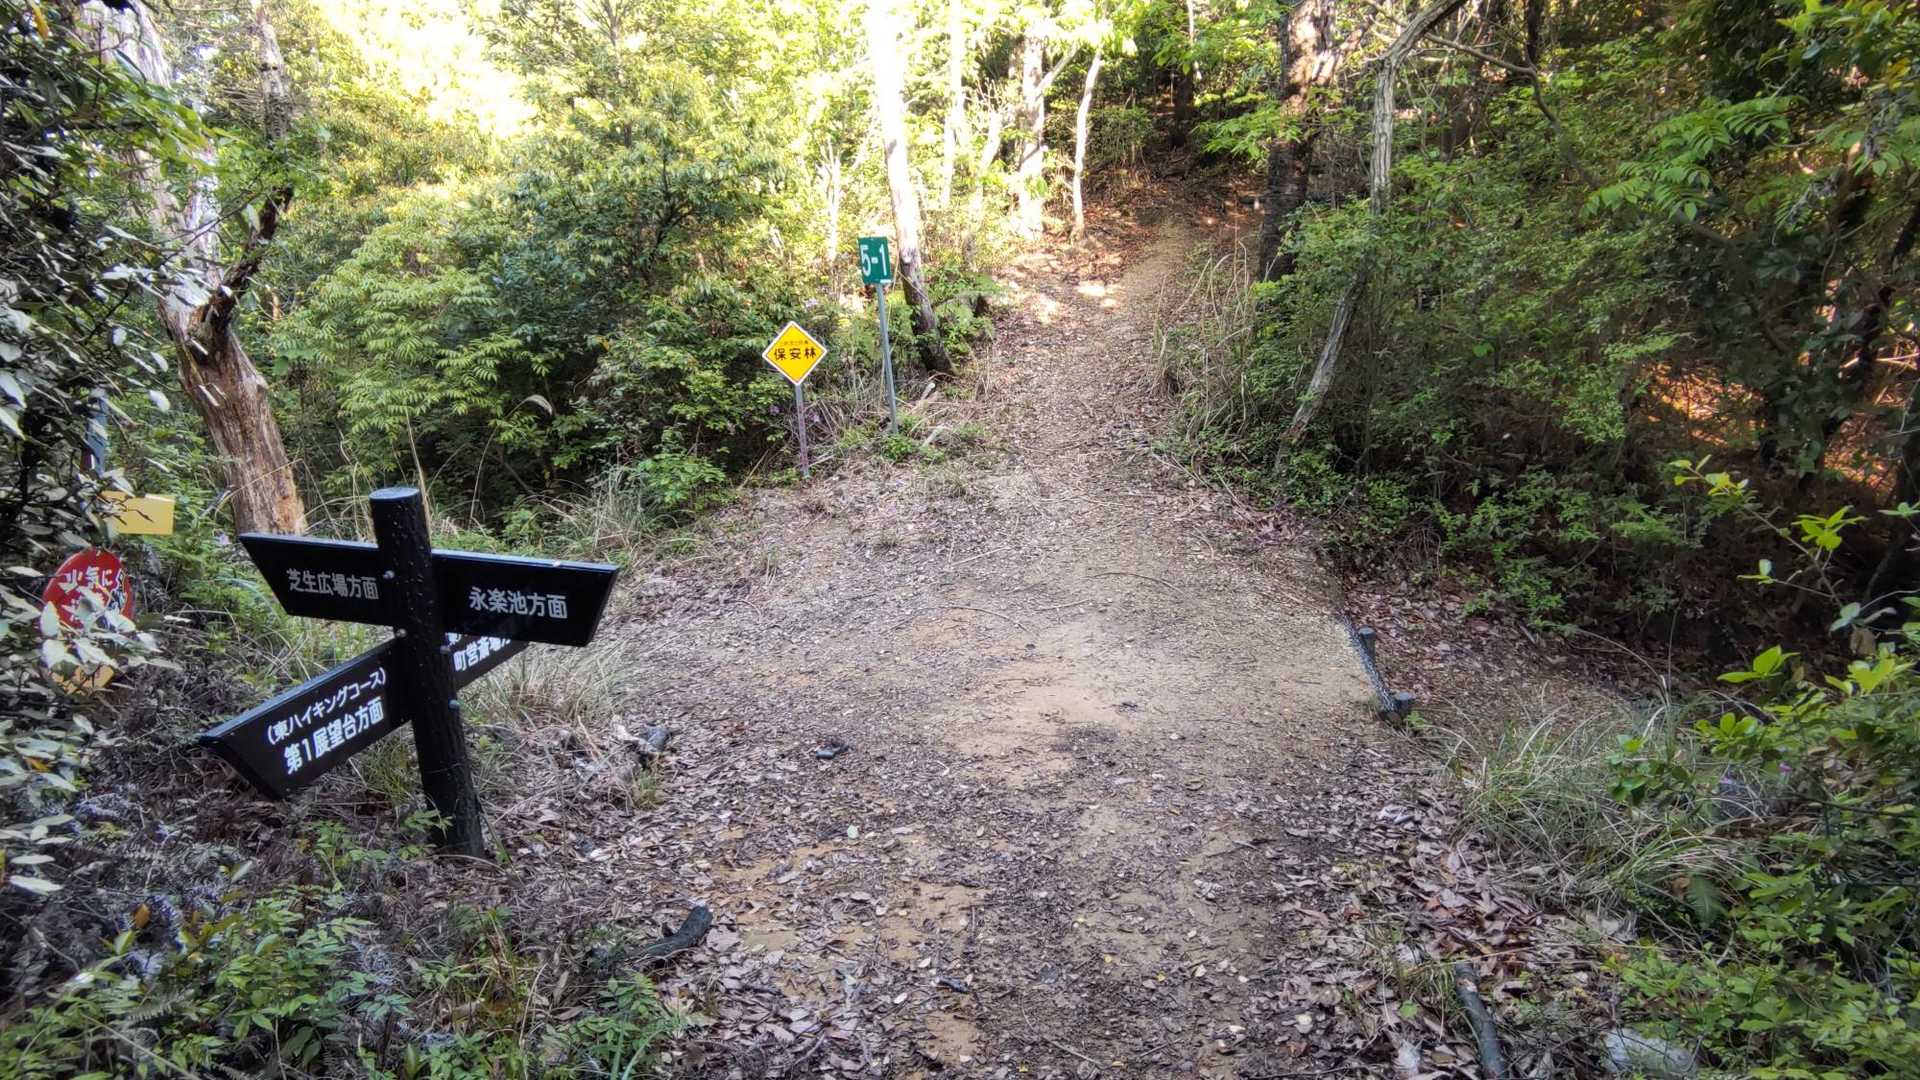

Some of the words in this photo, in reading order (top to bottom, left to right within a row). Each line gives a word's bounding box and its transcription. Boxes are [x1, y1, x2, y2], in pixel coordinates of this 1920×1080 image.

[860, 244, 887, 276] 5-1
[774, 347, 816, 360] 保安林
[286, 568, 379, 599] 芝生広場方面
[468, 586, 568, 619] 永楽池方面
[283, 697, 384, 775] 第1展望台方面
